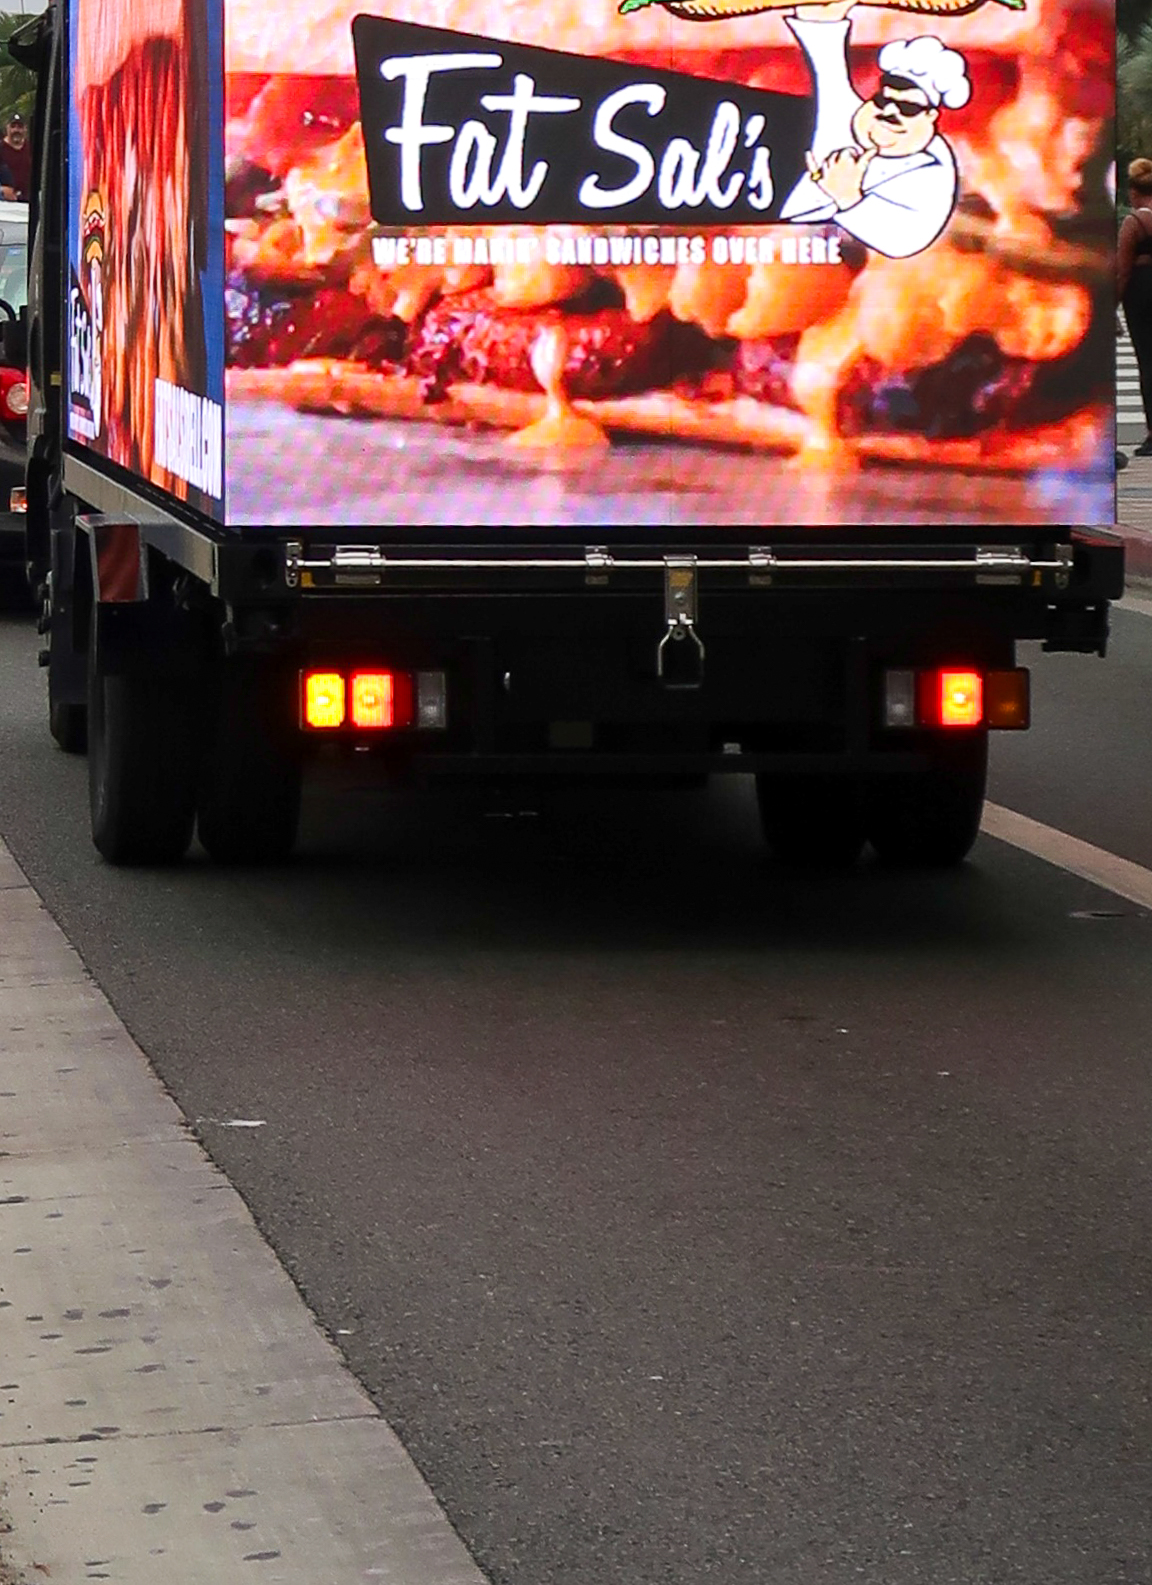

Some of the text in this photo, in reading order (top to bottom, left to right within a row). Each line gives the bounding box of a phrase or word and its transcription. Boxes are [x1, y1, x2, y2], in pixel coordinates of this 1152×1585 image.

[380, 51, 776, 213] Fat Sal's
[370, 236, 446, 265] WE'RE
[544, 236, 706, 265] SANDWICHES
[712, 236, 775, 265] OVER
[781, 236, 843, 265] HERE
